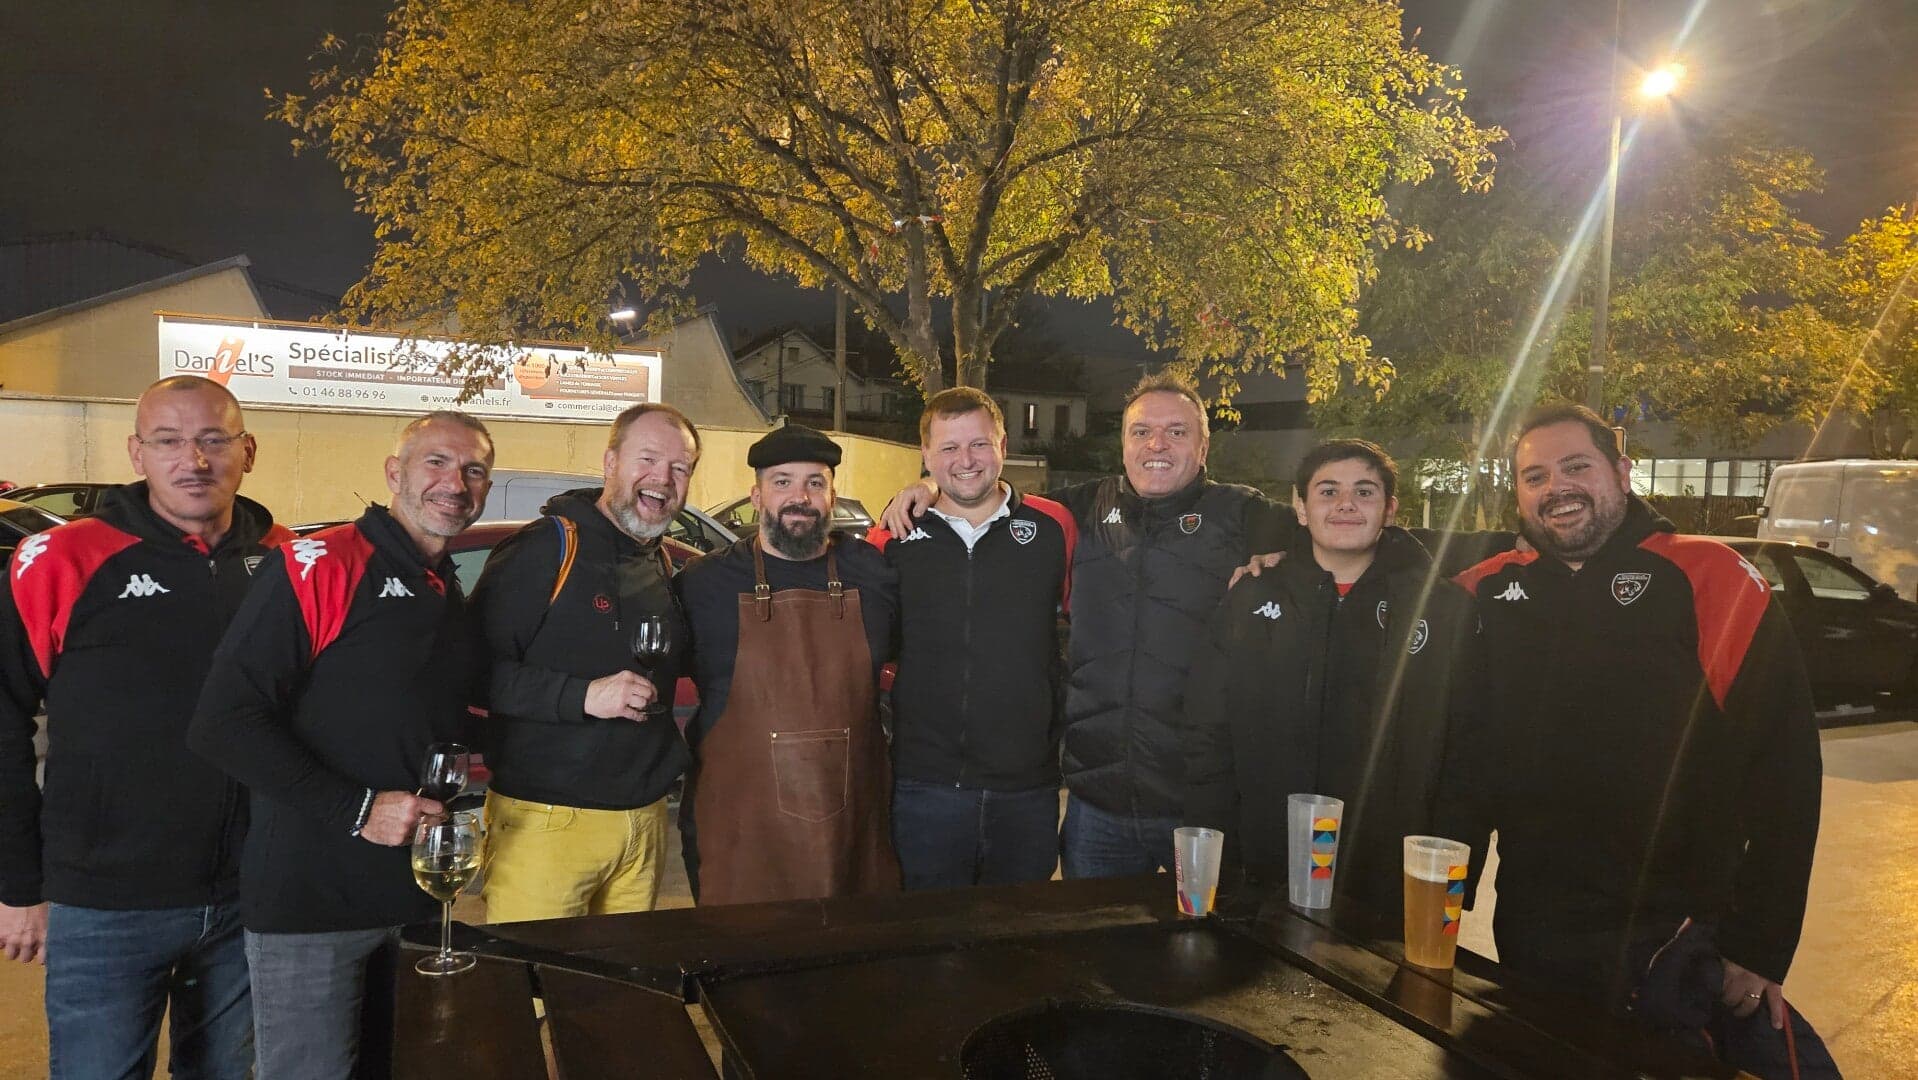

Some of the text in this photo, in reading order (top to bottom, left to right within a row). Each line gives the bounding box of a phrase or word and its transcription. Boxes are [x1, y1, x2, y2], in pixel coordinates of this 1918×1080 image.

[316, 370, 343, 379] STOCK
[345, 372, 385, 381] IMMEDIAT
[303, 386, 386, 400] 01 46 88 96 96
